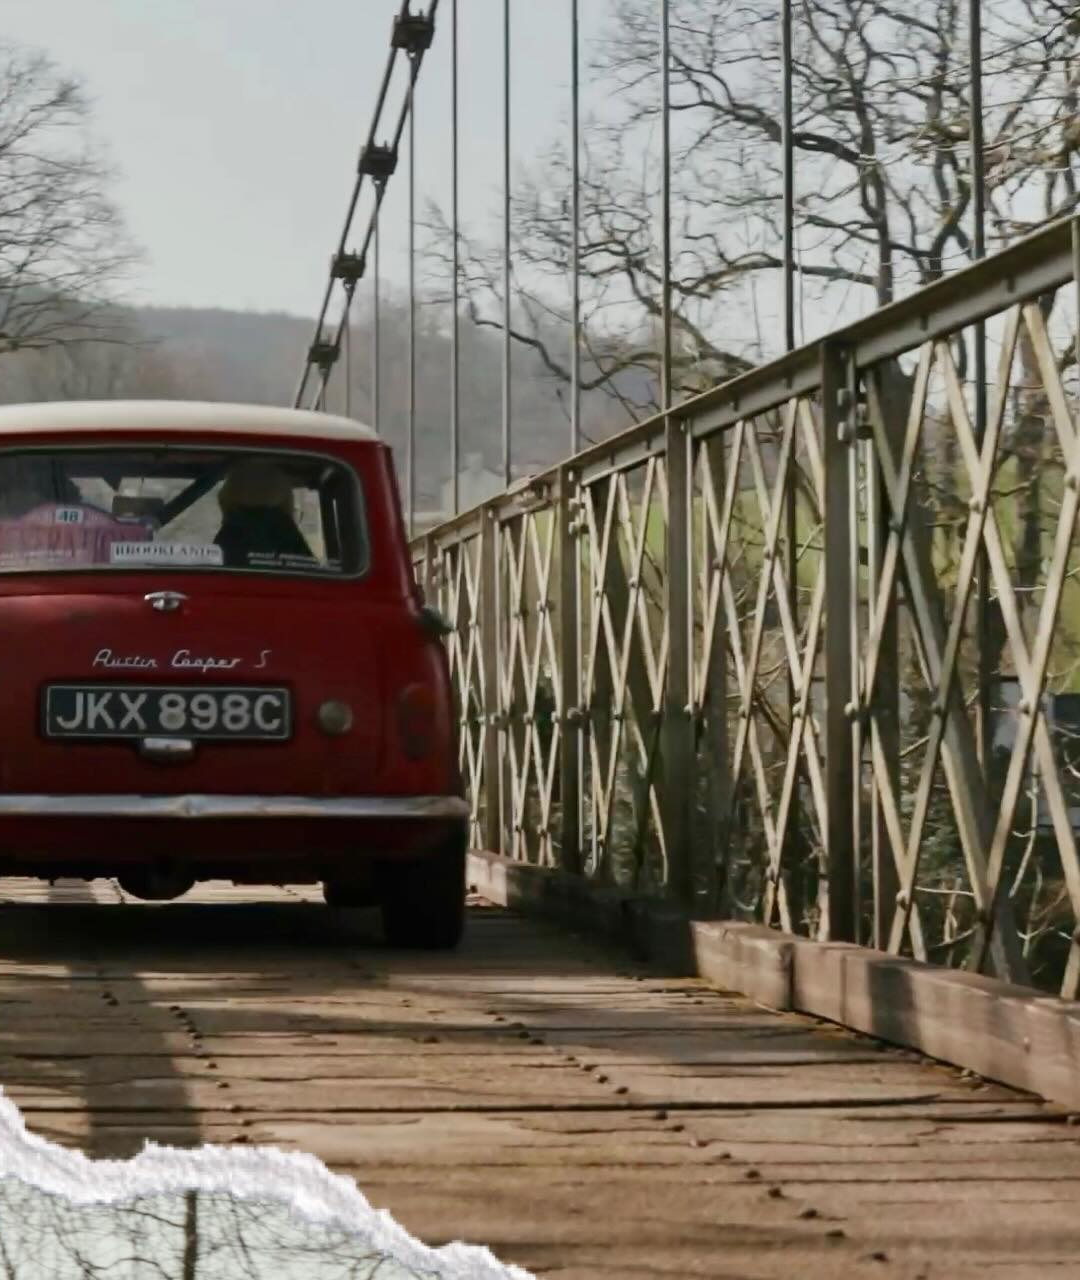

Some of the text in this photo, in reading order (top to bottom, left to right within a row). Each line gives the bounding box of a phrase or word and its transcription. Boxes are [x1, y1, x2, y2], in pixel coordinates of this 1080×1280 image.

[93, 649, 270, 672] Austin Cooper S
[56, 692, 281, 731] JKX 898C
